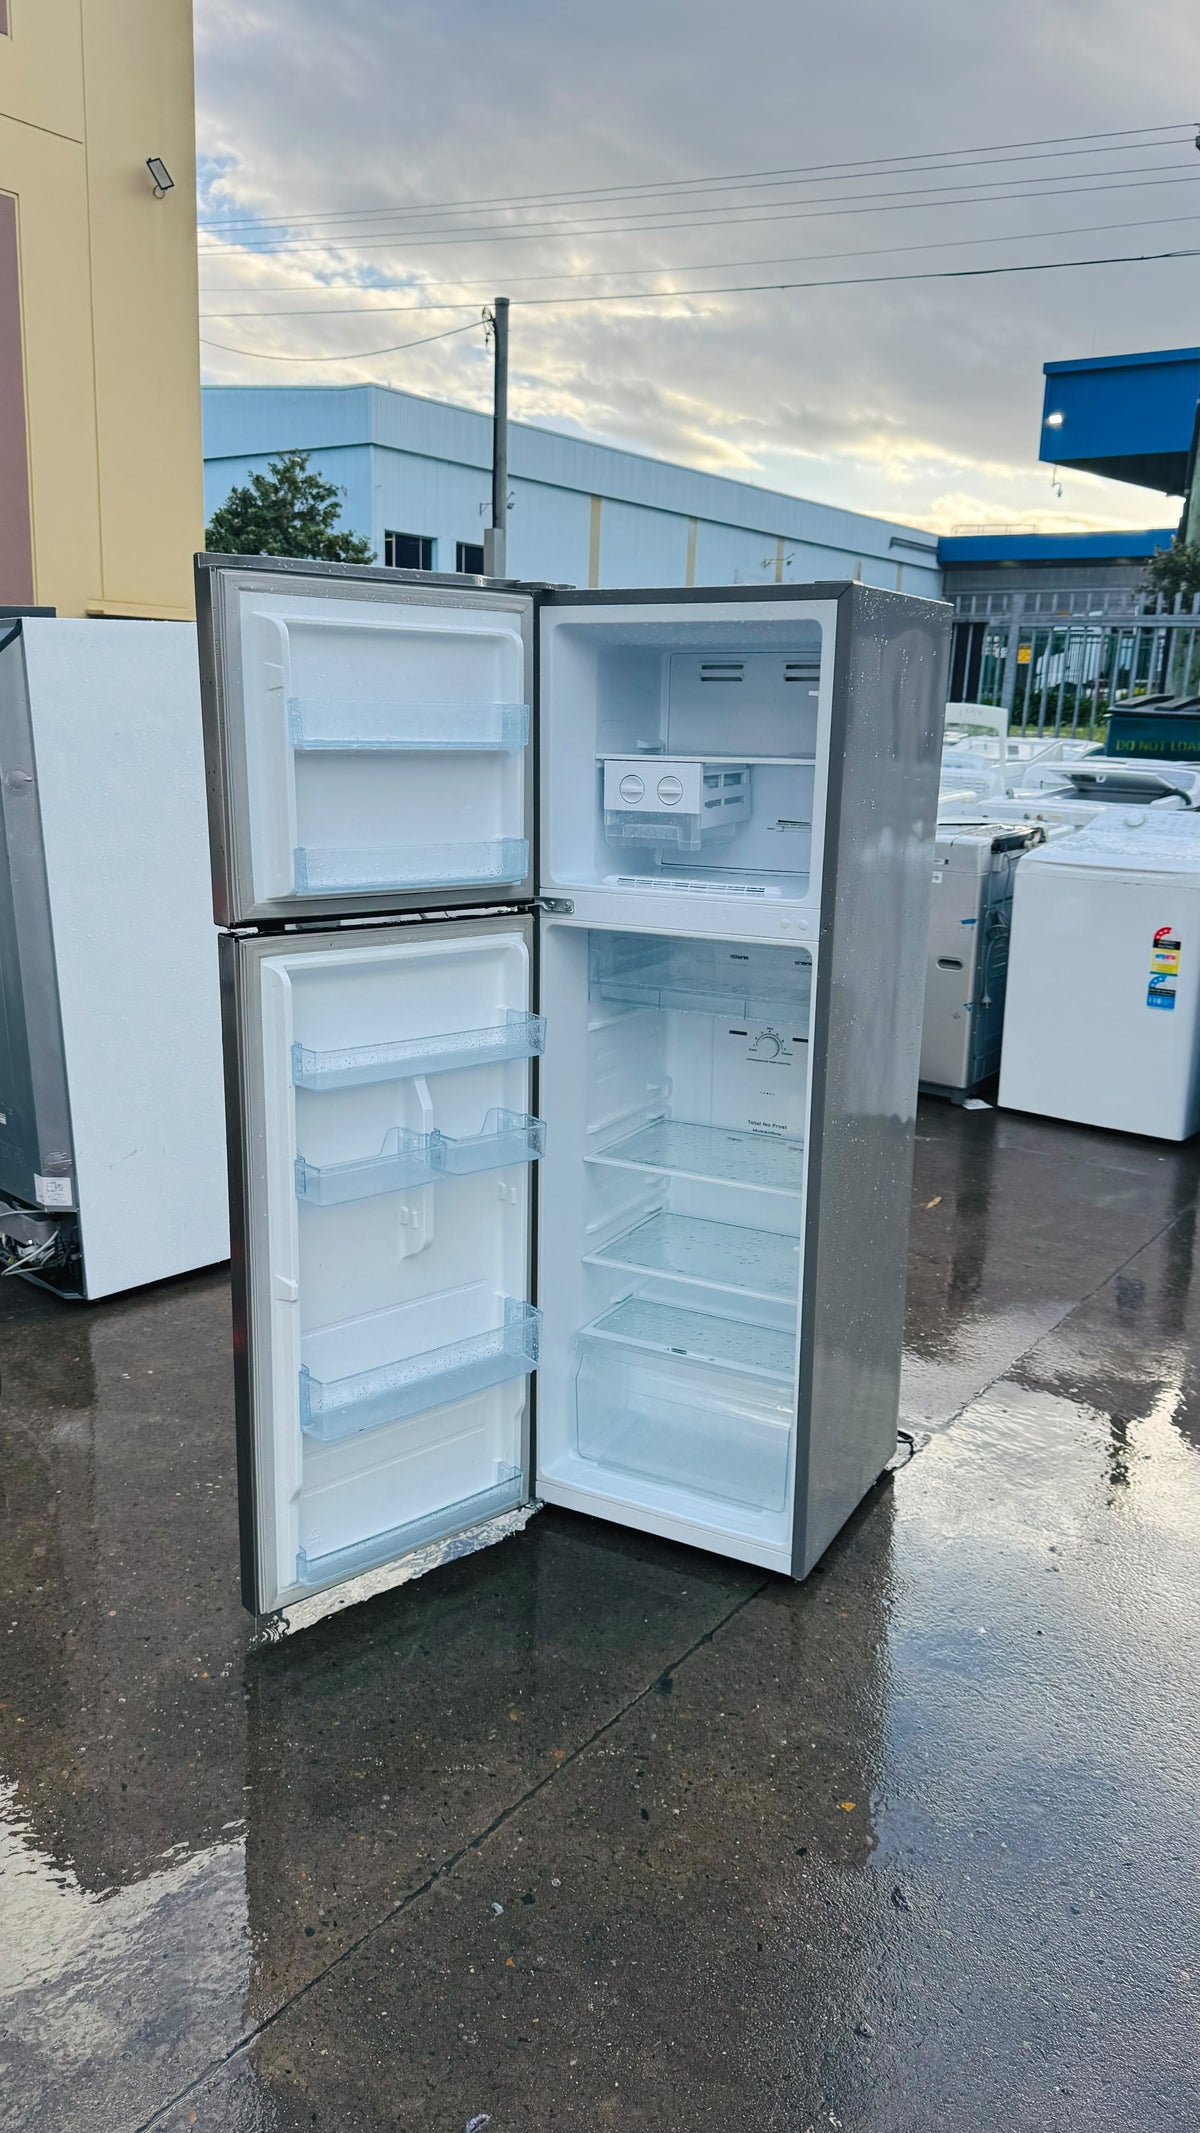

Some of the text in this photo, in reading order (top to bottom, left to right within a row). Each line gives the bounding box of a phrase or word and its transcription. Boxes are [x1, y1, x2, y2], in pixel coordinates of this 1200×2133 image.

[1115, 740, 1200, 752] DO NOT LOA
